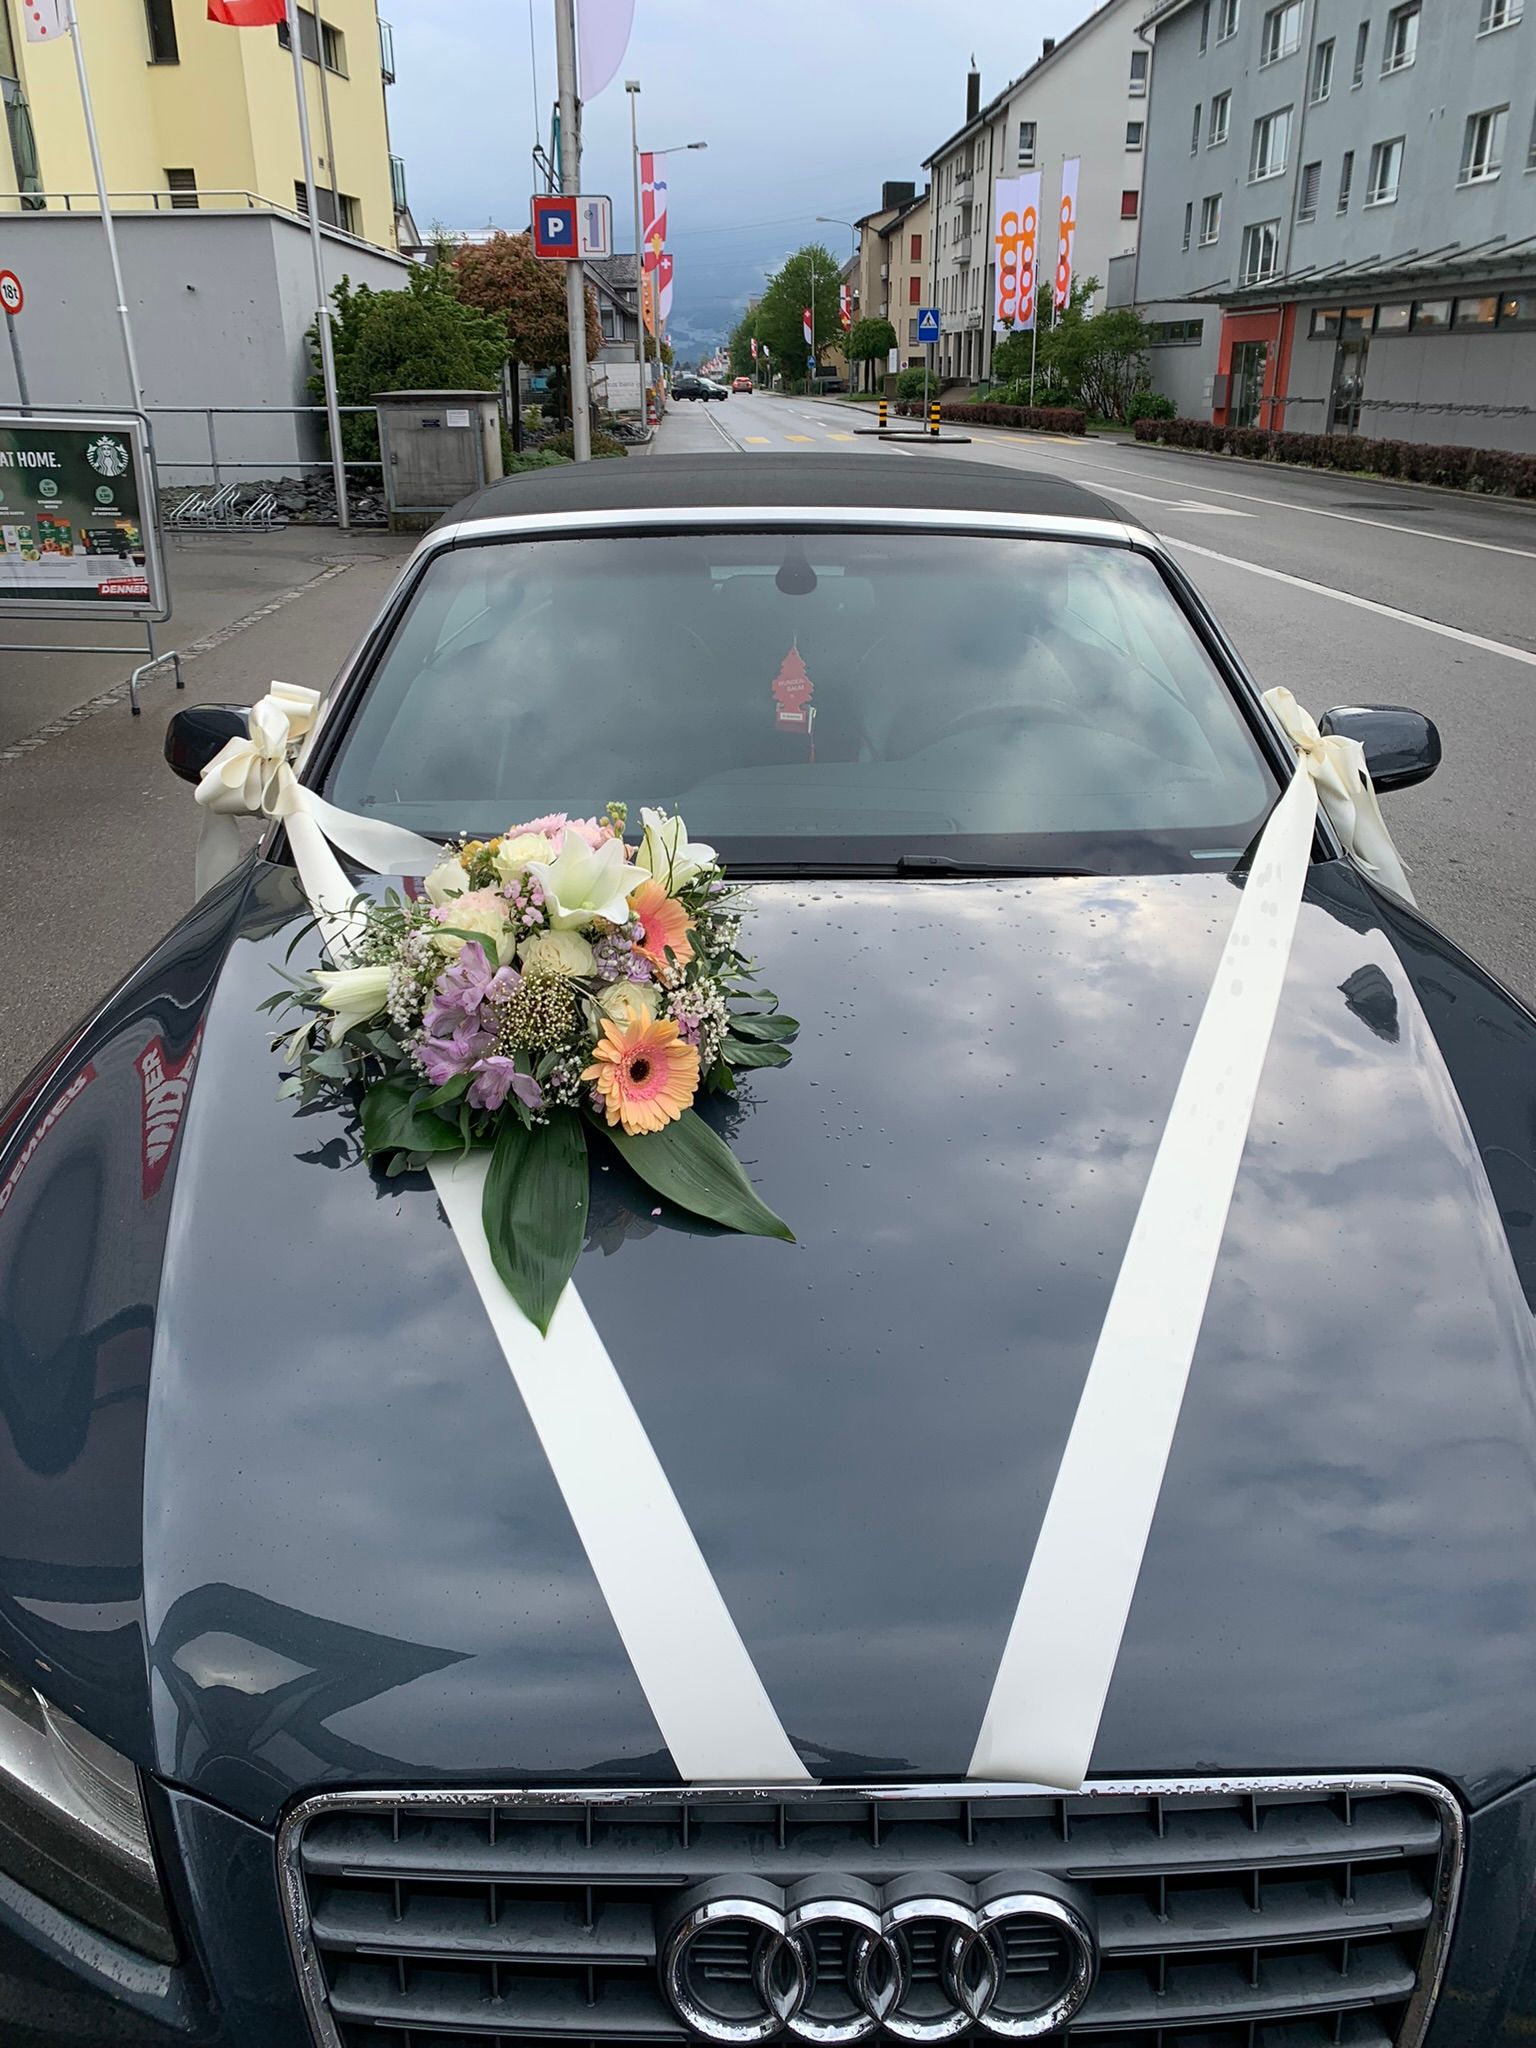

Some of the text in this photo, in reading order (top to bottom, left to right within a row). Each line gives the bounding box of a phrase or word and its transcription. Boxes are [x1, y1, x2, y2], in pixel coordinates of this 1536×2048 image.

[547, 217, 564, 238] P
[2, 284, 19, 300] 18t
[0, 451, 62, 468] AT HOME.
[101, 584, 148, 594] DENNER
